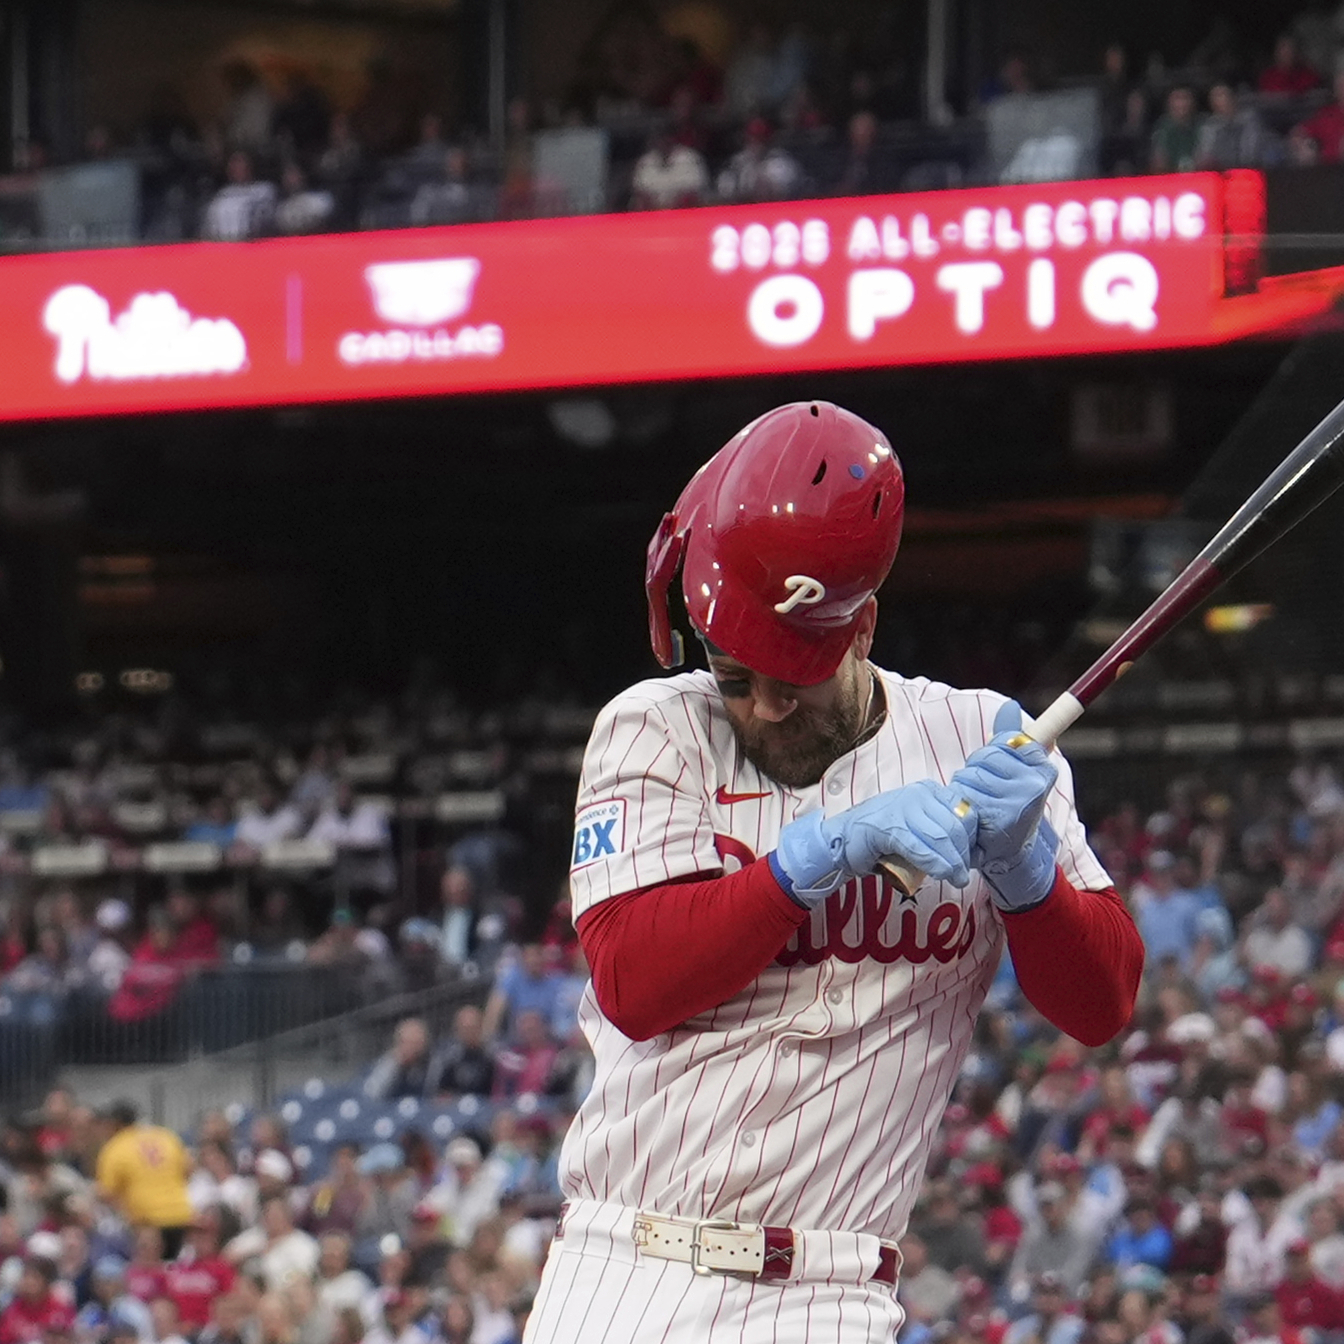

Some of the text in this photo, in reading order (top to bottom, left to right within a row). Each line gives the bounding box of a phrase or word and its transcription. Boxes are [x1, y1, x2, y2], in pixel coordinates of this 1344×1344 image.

[847, 192, 1206, 260] ALL-ELECTRIC
[747, 250, 1158, 348] OPTIQ
[774, 574, 826, 613] P
[573, 818, 618, 865] BX
